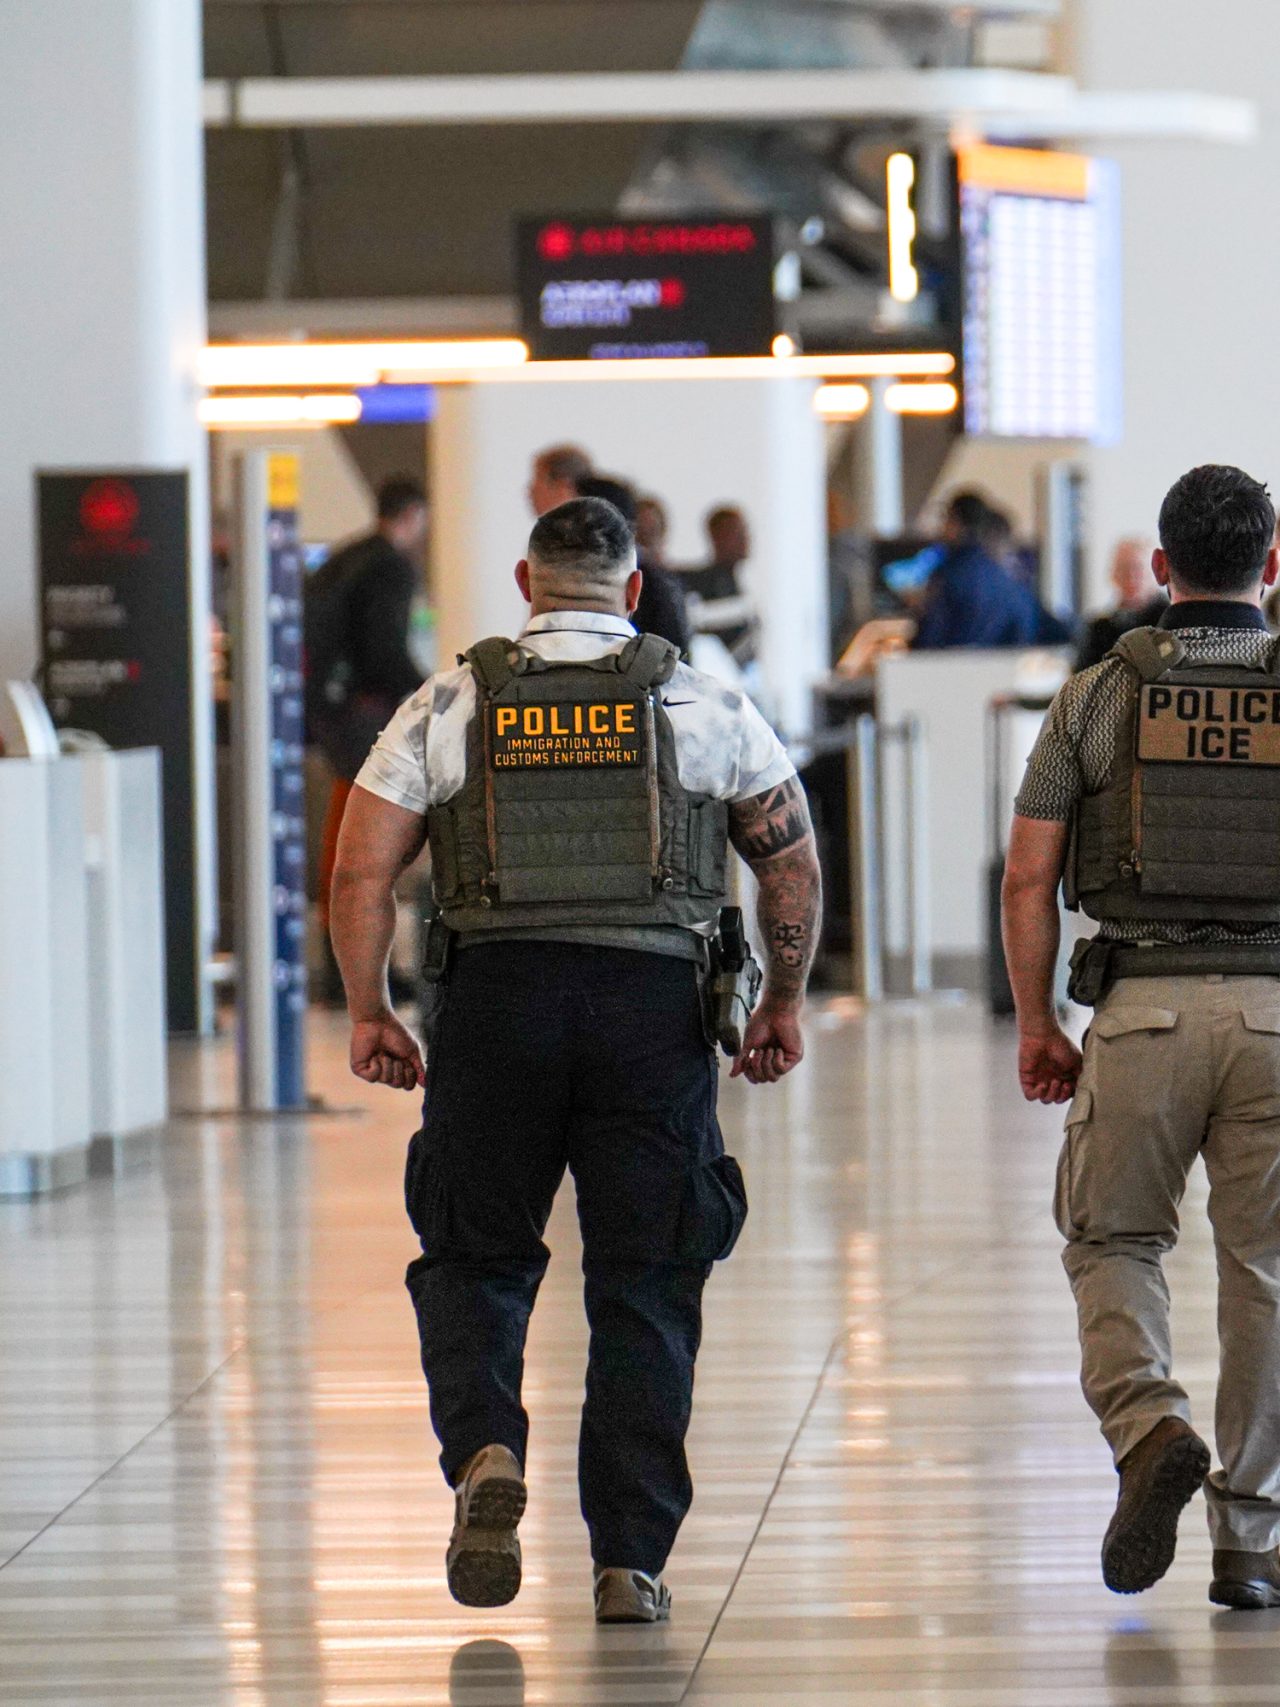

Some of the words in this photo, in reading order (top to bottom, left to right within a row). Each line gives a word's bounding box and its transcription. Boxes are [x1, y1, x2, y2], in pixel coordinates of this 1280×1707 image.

[496, 704, 636, 736] POLICE
[507, 737, 590, 750] IMMIGRATION
[596, 737, 621, 749] AND
[1187, 727, 1251, 759] ICE
[495, 751, 549, 766] CUSTOMS
[554, 750, 638, 764] ENFORCEMENT
